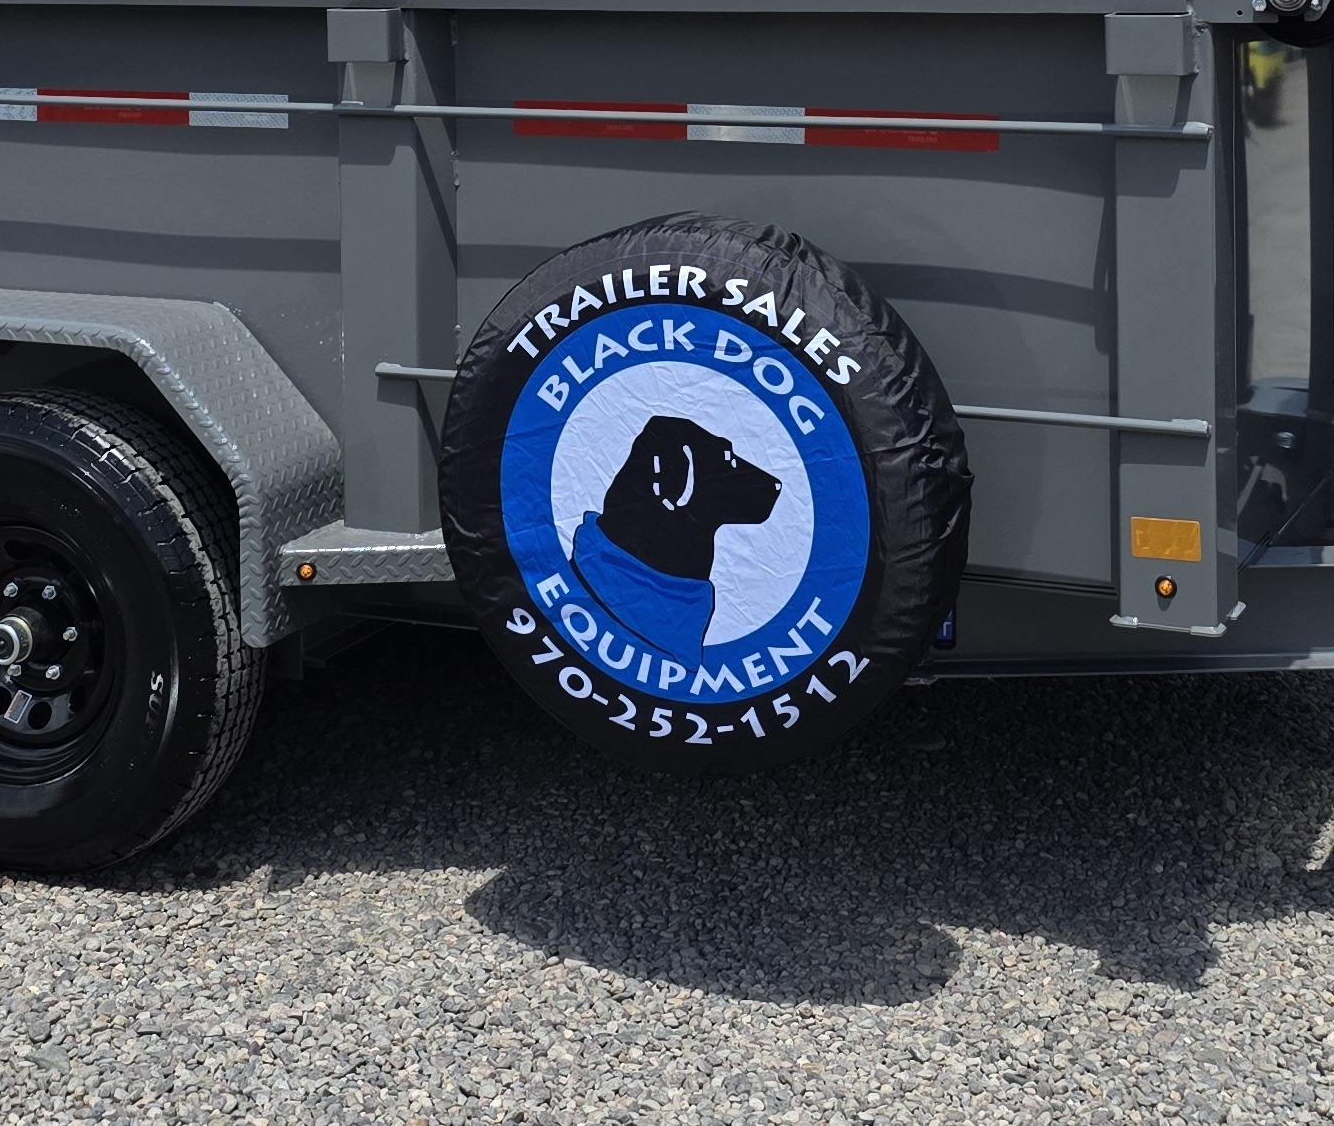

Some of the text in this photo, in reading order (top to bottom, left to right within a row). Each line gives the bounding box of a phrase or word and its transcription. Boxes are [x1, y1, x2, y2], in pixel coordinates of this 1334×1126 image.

[507, 264, 862, 385] TRAILER SALES
[537, 319, 825, 435] BLACK DOG
[506, 607, 871, 745] 970-252-1512
[536, 573, 835, 696] EQUIPMENT
